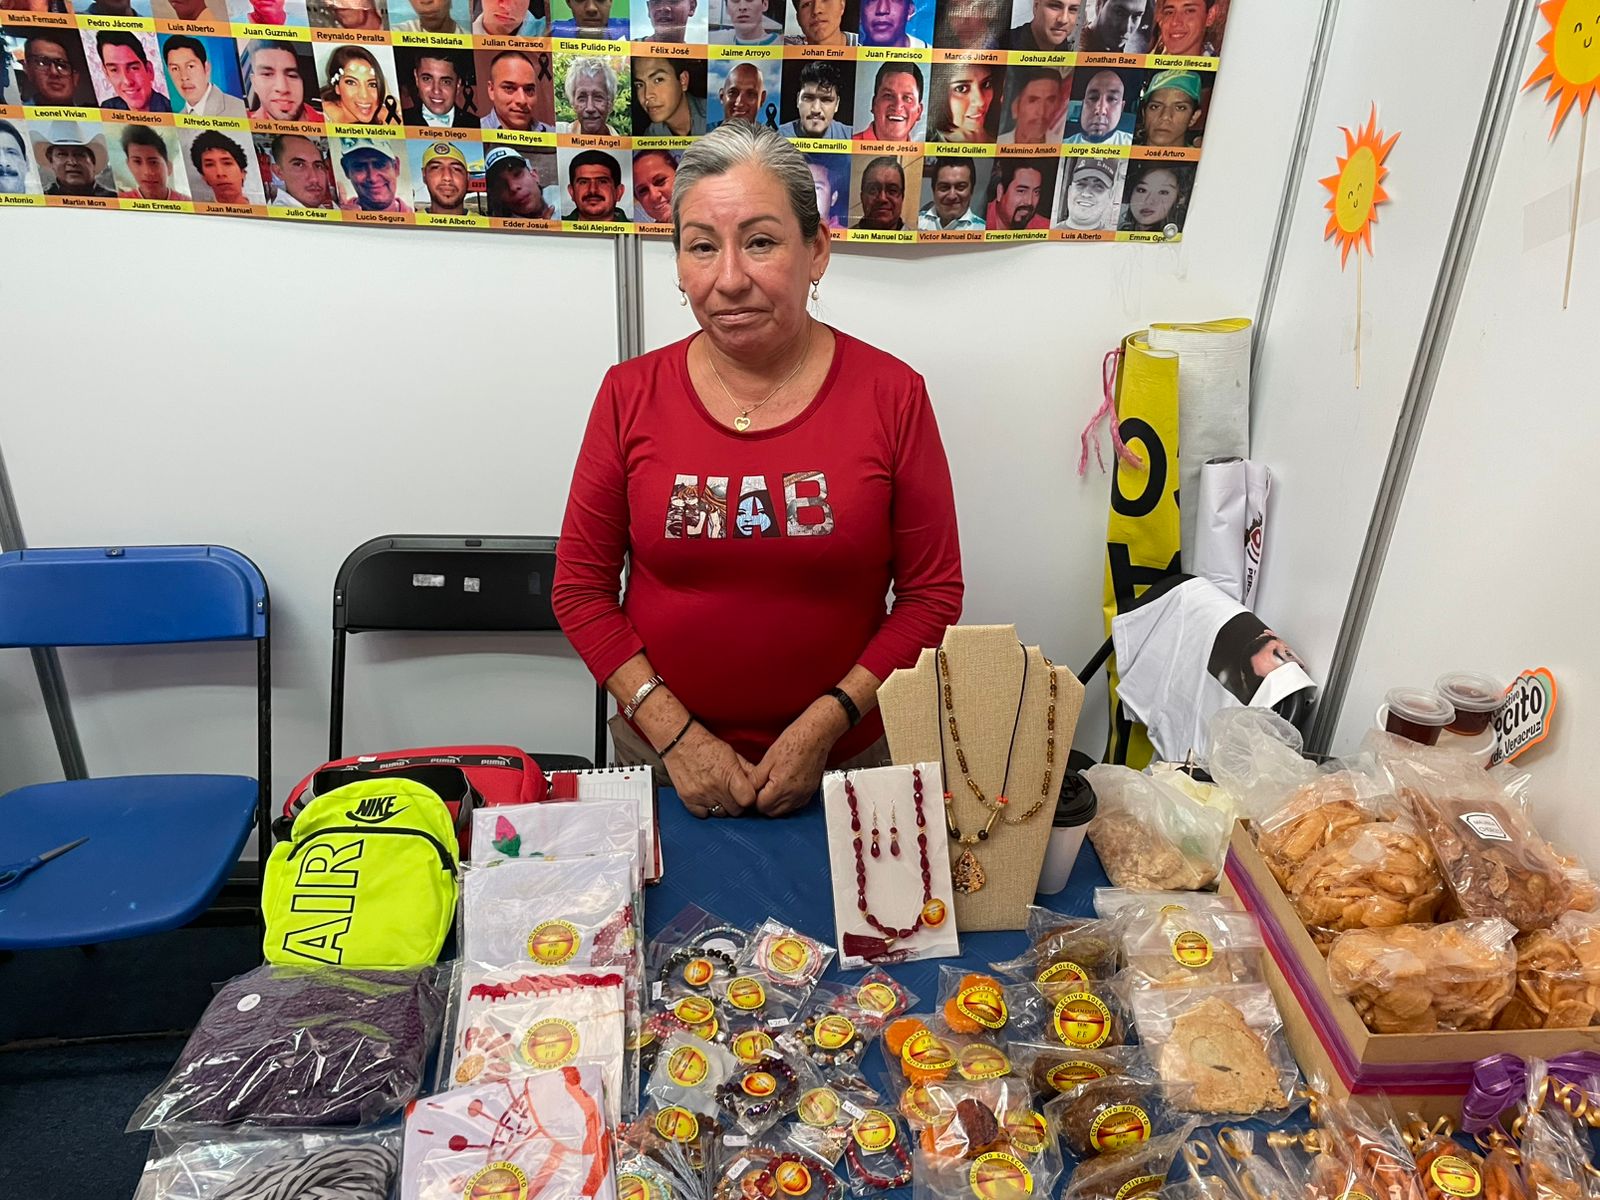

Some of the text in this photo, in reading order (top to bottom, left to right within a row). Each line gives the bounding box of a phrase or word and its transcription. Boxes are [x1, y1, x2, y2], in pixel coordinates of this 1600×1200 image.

[87, 18, 144, 28] Pedro Jácome
[167, 22, 215, 33] Luis Alberto
[243, 28, 298, 38] Juan Guzmán
[316, 32, 385, 42] Reynaldo Peralta
[402, 35, 463, 46] Michel Saldaña
[508, 39, 544, 48] Carrasco
[581, 42, 606, 52] Pulido
[650, 46, 689, 55] Félix José
[720, 48, 771, 58] Jaime Arroyo
[802, 48, 844, 57] Johan Emir
[865, 50, 922, 59] Juan Francisco
[973, 52, 998, 62] Jibrán
[1020, 54, 1047, 63] Joshua
[1085, 56, 1117, 64] Jonathan
[1155, 58, 1182, 67] Ricardo
[34, 110, 87, 118] Leonel Vivian
[111, 112, 162, 123] Jair Desiderio
[184, 117, 240, 128] Alfredo Ramón
[254, 122, 321, 133] José Tomás Oliva
[335, 126, 396, 136] Maribel Valdivia
[419, 129, 467, 139] Felipe Diego
[496, 132, 542, 144] Mario Reyes
[571, 137, 597, 147] Miguel
[637, 138, 667, 147] Gerardo
[812, 142, 847, 150] Camarillo
[962, 146, 986, 154] Guillén
[1069, 147, 1120, 156] Jorge Sánchez
[152, 202, 181, 210] Ernesto
[226, 206, 252, 214] Manuel
[306, 210, 328, 218] César
[356, 213, 405, 223] Lucio Segura
[449, 218, 476, 226] Alberto
[526, 221, 549, 229] Josué
[572, 223, 625, 233] Saúl Alejandro
[1013, 231, 1047, 239] Hernández
[665, 471, 835, 538] MAB
[1504, 721, 1541, 754] Veracruz
[355, 796, 397, 817] NIKE
[282, 839, 364, 965] AIR
[1054, 963, 1083, 976] SOLECITO
[1054, 993, 1110, 1022] COLECTIVO SOLECITO
[1090, 1106, 1149, 1137] COLECTIVO SOLECITO
[996, 1153, 1029, 1175] SOLECITO
[464, 1162, 528, 1196] COLECTIVO SOLECITO
[1116, 1177, 1146, 1200] OLECTIVO
